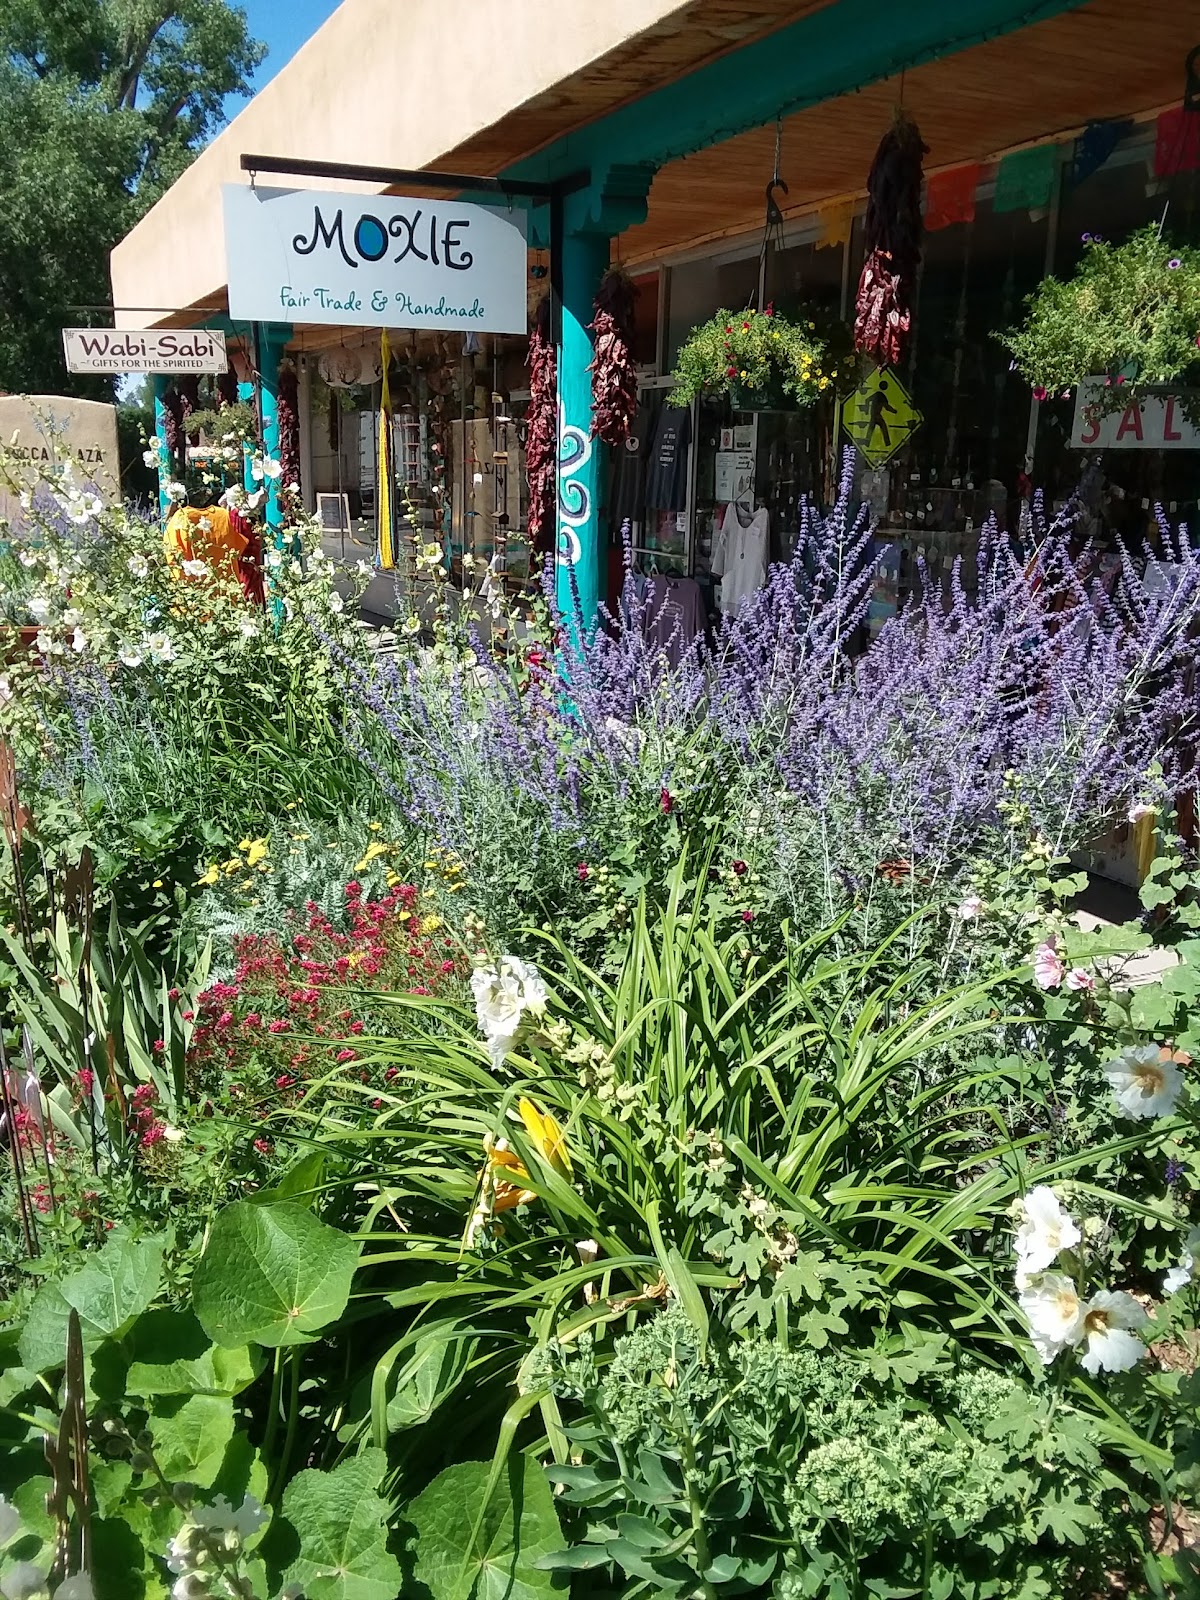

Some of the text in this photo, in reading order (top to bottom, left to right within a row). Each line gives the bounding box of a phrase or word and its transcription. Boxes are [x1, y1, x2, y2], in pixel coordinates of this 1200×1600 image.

[293, 205, 473, 270] MOXIE
[280, 286, 485, 318] Fair Trade & Handmade
[79, 334, 214, 357] Wabi-Sabi
[92, 359, 203, 368] GIFTS FOR THE SPIRITED
[57, 448, 104, 463] AZA
